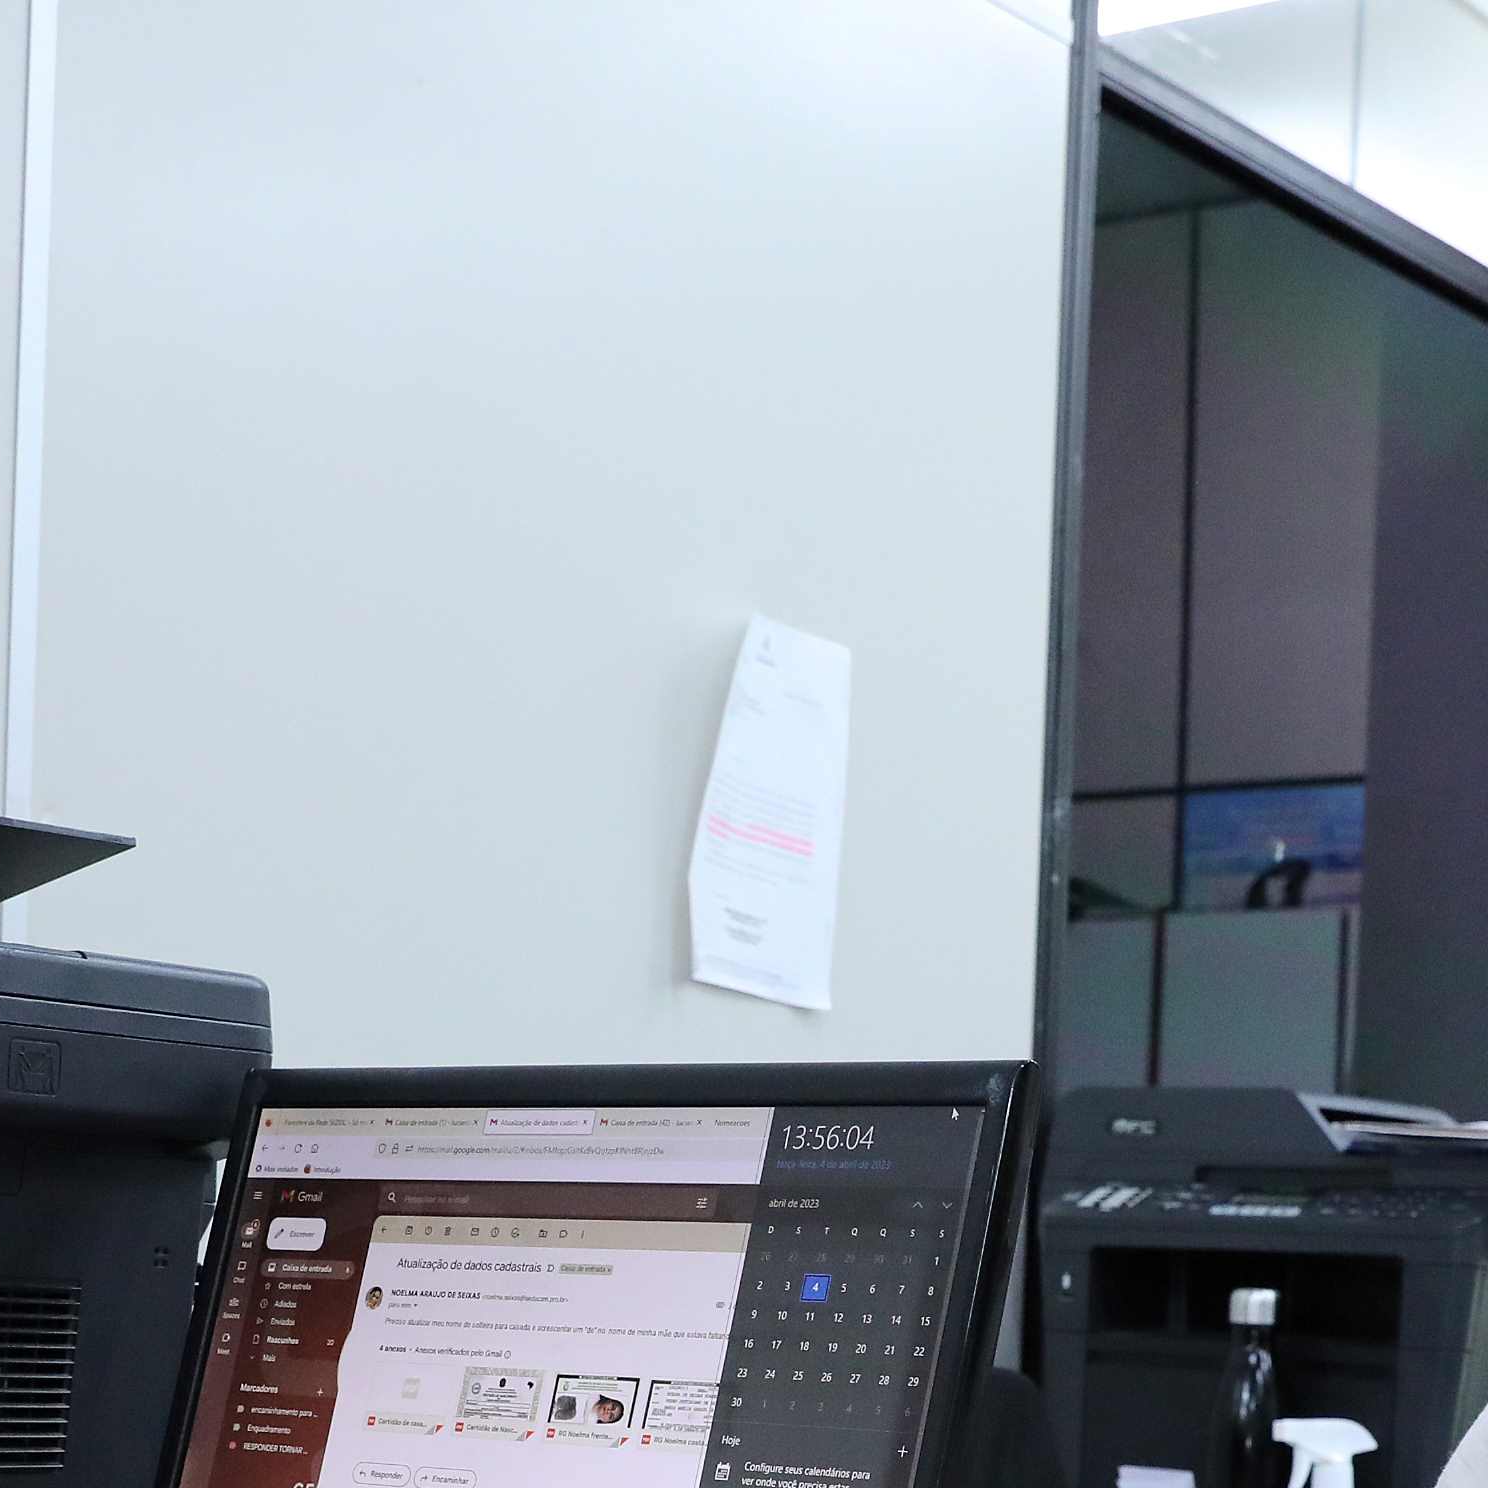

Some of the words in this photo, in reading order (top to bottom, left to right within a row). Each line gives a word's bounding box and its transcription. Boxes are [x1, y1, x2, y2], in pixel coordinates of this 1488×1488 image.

[778, 1124, 877, 1150] 13:56:04
[296, 1191, 324, 1202] Gmail
[767, 1198, 786, 1208] abril
[787, 1198, 799, 1208] de
[799, 1199, 820, 1209] 2023
[767, 1225, 775, 1234] D
[794, 1226, 802, 1235] S
[822, 1226, 830, 1235] T
[850, 1227, 859, 1236] Q
[879, 1228, 887, 1237] Q
[909, 1229, 916, 1238] S
[937, 1229, 945, 1239] S
[281, 1263, 300, 1272] Caixa
[308, 1265, 333, 1273] entrada
[395, 1257, 449, 1272] Atualização
[449, 1259, 463, 1270] de
[462, 1259, 493, 1271] dados
[493, 1260, 542, 1273] cadastrais
[390, 1289, 418, 1297] NOELMA
[418, 1290, 446, 1298] ARAUJO
[456, 1291, 481, 1299] SEIXAS
[756, 1280, 764, 1290] 2
[784, 1281, 792, 1291] 3
[811, 1282, 820, 1292] 4
[839, 1283, 847, 1293] 5
[868, 1284, 876, 1294] 6
[897, 1285, 905, 1295] 7
[927, 1286, 935, 1296] 8
[750, 1309, 758, 1319] 9
[776, 1310, 788, 1320] 10
[804, 1311, 815, 1321] 11
[832, 1312, 844, 1322] 12
[861, 1313, 872, 1324] 13
[890, 1315, 902, 1325] 14
[919, 1316, 931, 1326] 15
[484, 1349, 502, 1357] Gmail
[743, 1338, 755, 1348] 16
[771, 1339, 782, 1350] 17
[799, 1341, 810, 1351] 18
[827, 1342, 839, 1352] 19
[854, 1343, 867, 1354] 20
[883, 1344, 896, 1355] 21
[912, 1345, 926, 1356] 22
[736, 1367, 748, 1378] 23
[763, 1368, 776, 1379] 24
[792, 1370, 804, 1380] 25
[820, 1371, 833, 1382] 26
[848, 1373, 861, 1383] 27
[878, 1374, 891, 1385] 28
[906, 1376, 920, 1387] 29
[239, 1383, 279, 1394] Marcadores
[730, 1397, 743, 1407] 30
[720, 1434, 741, 1446] Hoje
[242, 1441, 278, 1452] RESPONDER
[369, 1469, 403, 1481] Responder
[431, 1474, 469, 1486] Encaminhar
[743, 1460, 783, 1476] Configure
[783, 1465, 803, 1476] seus
[803, 1464, 851, 1480] calendários
[850, 1470, 871, 1483] para
[740, 1477, 755, 1486] ver
[754, 1476, 777, 1488] onde
